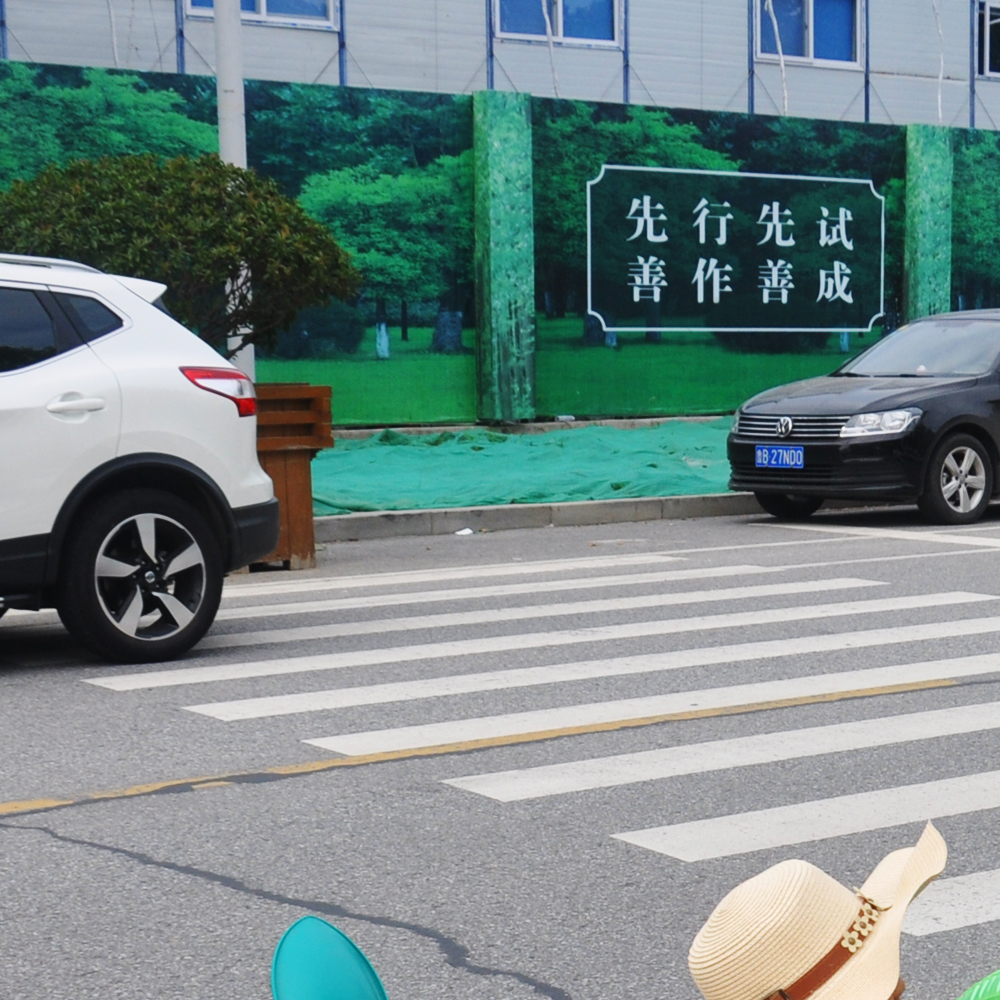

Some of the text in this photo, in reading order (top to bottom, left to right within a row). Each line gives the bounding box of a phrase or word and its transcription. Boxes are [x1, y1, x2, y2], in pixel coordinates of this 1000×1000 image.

[626, 195, 854, 250] 先行先试
[626, 255, 854, 304] 善作善成
